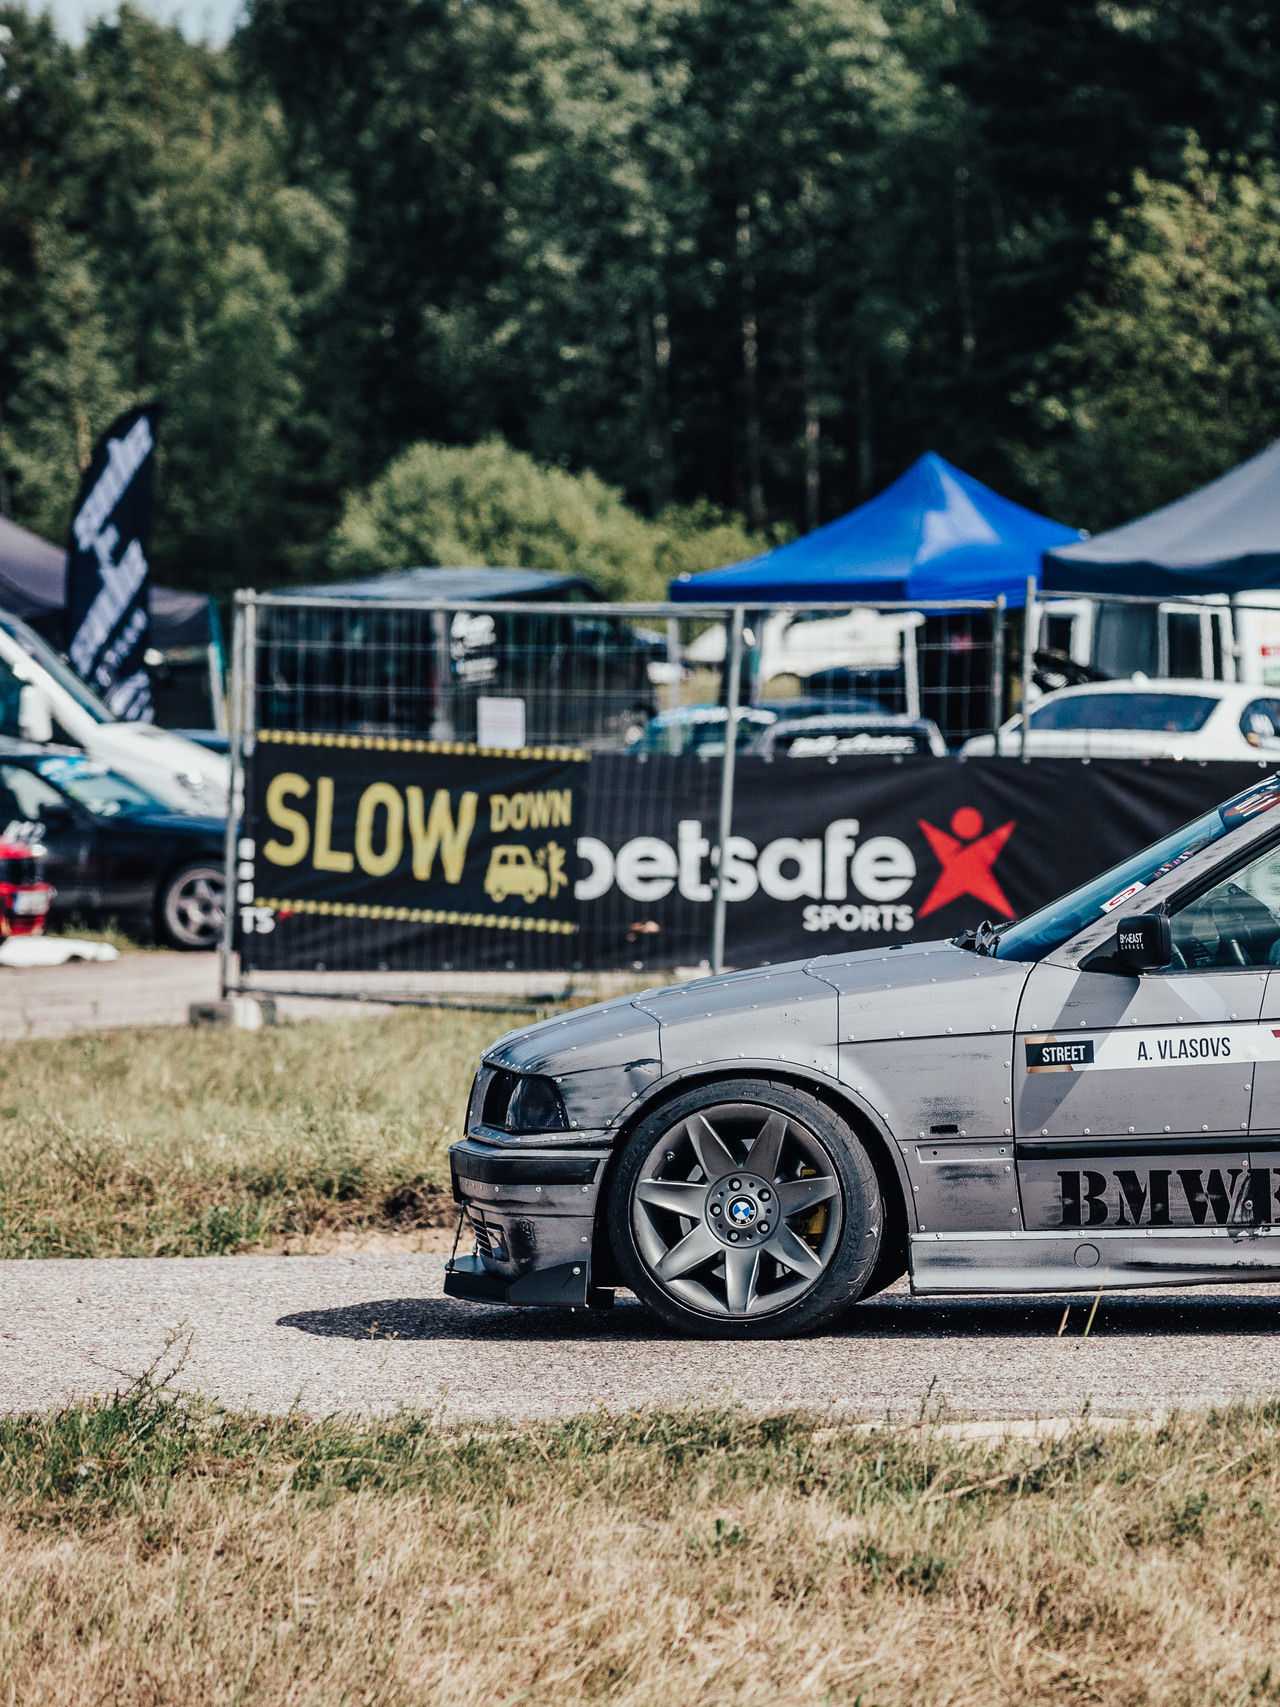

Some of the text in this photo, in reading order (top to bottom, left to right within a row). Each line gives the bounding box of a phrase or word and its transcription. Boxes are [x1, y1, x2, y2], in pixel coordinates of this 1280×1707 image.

[263, 772, 479, 884] SLOW
[489, 788, 573, 833] DOWN
[803, 904, 914, 931] SPORTS
[1041, 1045, 1086, 1063] STREET
[1137, 1036, 1231, 1061] A. VLASOVS
